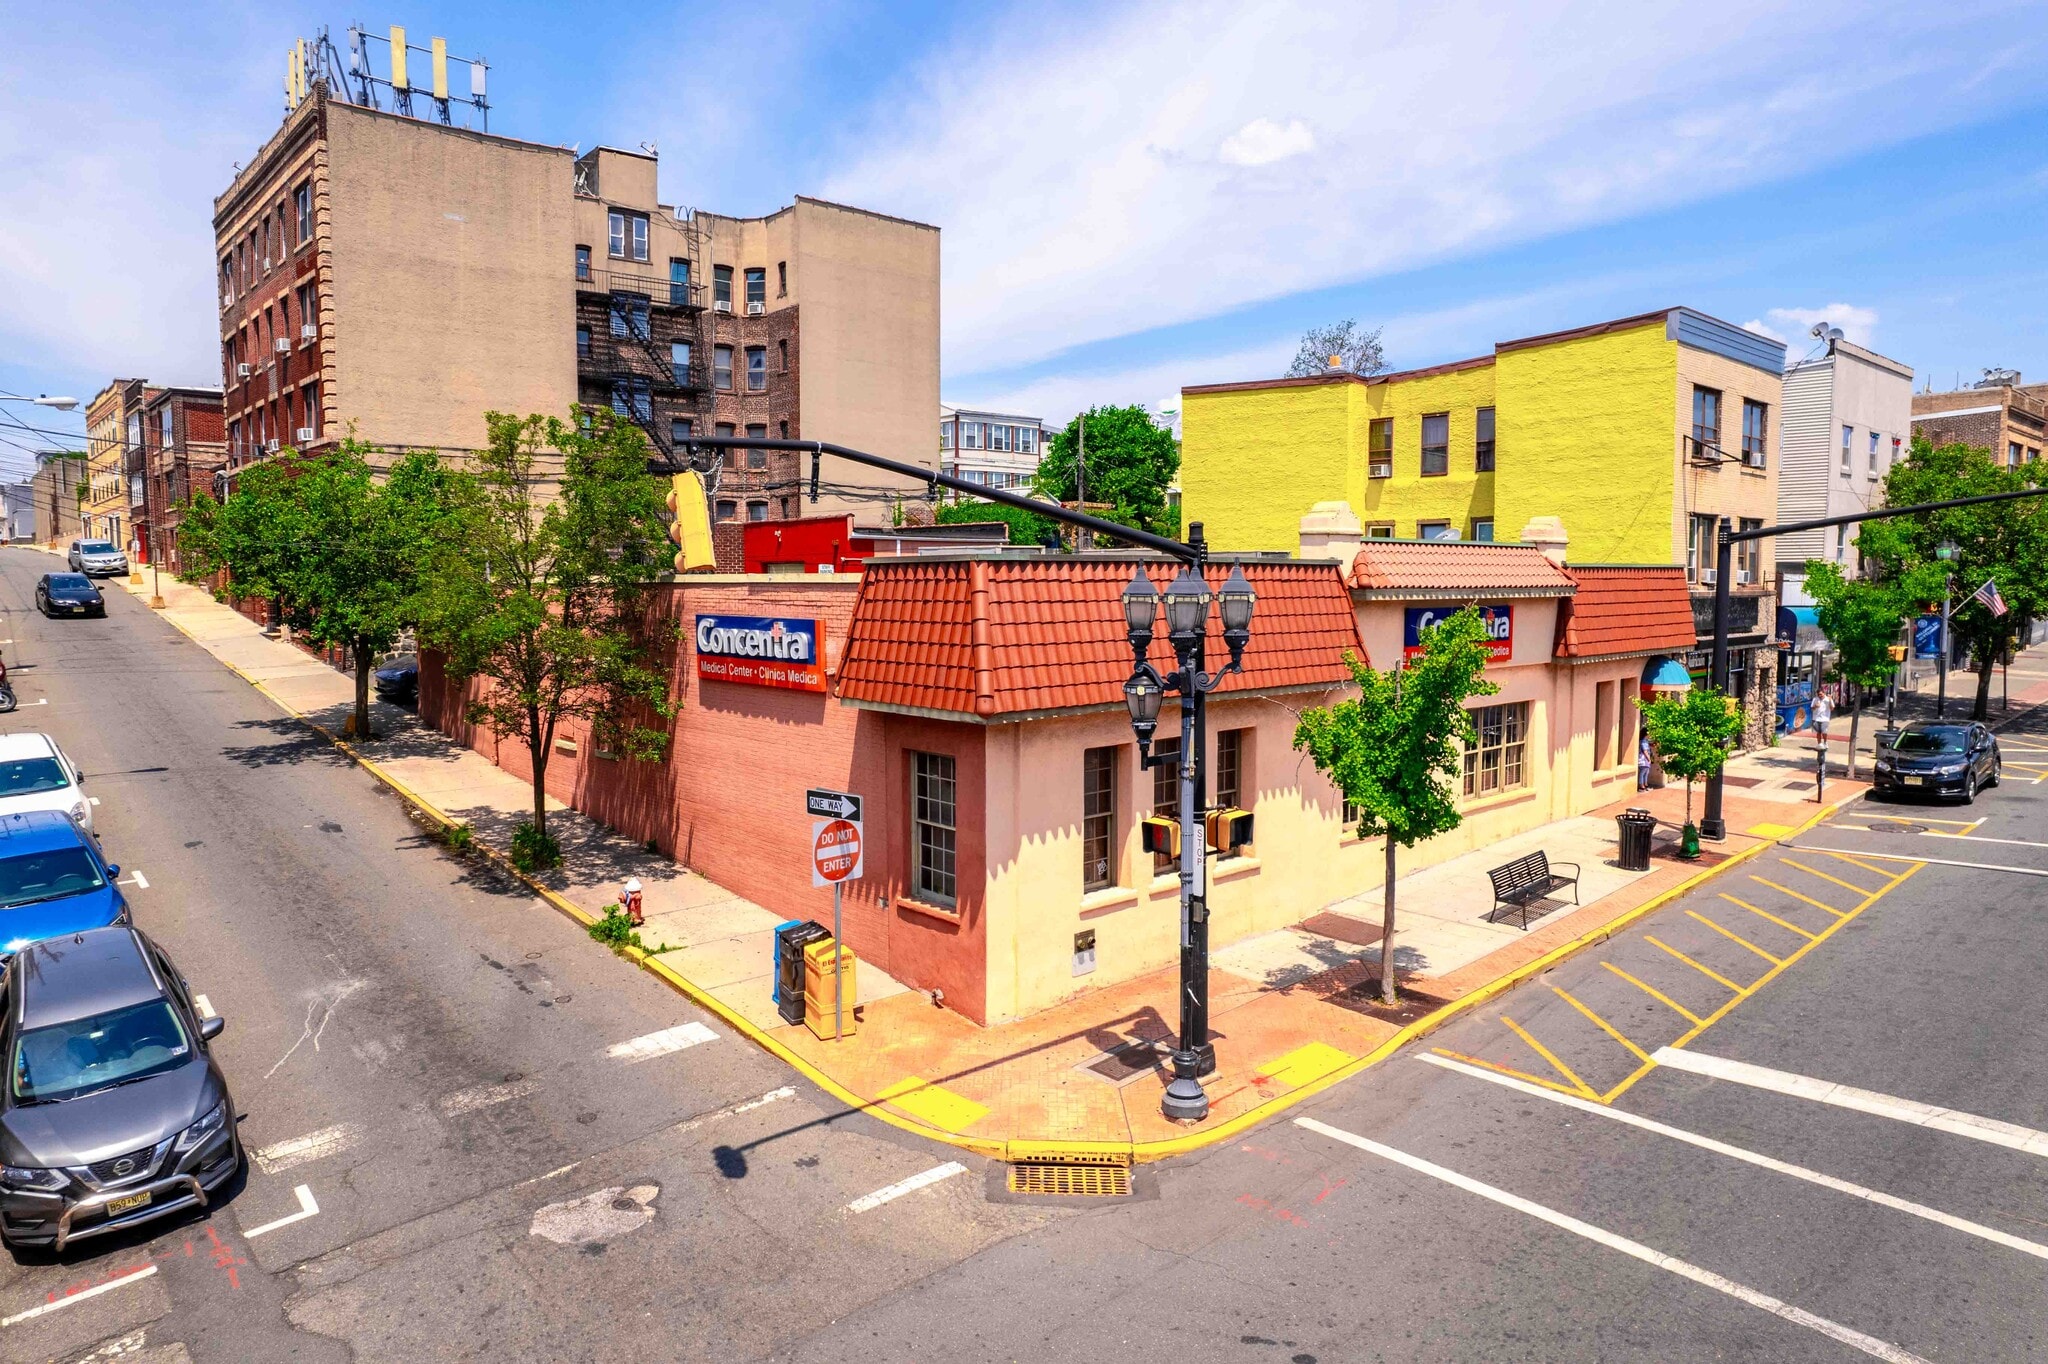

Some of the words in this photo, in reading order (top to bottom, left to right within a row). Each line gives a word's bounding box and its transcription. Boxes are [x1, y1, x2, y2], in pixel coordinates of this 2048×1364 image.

[697, 618, 809, 660] Concentra
[701, 660, 727, 674] Medical
[728, 663, 753, 677] Center
[810, 797, 824, 809] ONE
[828, 800, 843, 811] WAY
[821, 832, 834, 845] DO
[837, 828, 854, 842] NOT
[823, 857, 852, 873] ENTER
